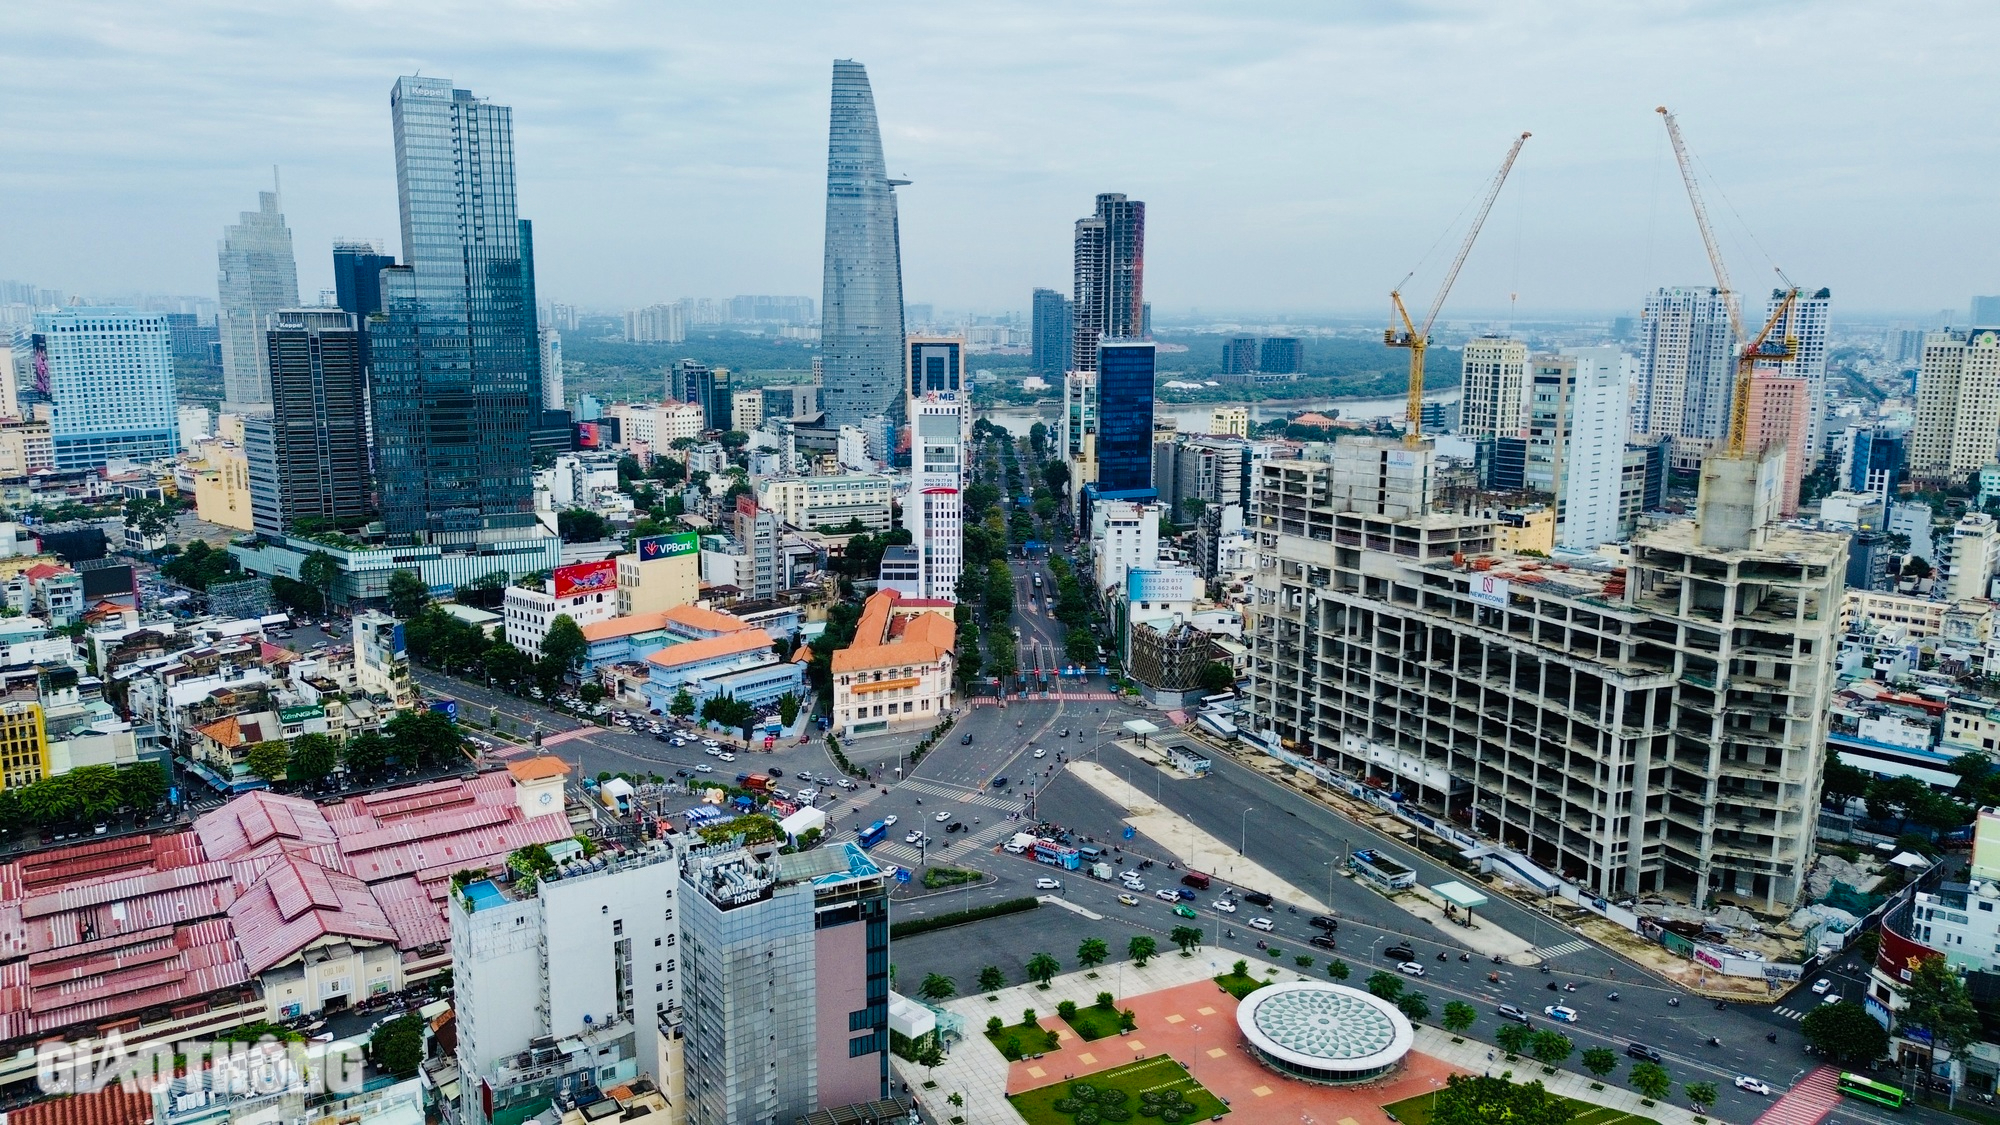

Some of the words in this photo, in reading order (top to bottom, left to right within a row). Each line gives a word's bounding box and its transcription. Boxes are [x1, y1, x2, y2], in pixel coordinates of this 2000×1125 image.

[411, 87, 444, 96] Keppel
[939, 393, 955, 401] MB
[660, 540, 694, 553] VPBank
[1470, 591, 1504, 603] NEWTECONS
[734, 889, 760, 904] hotel
